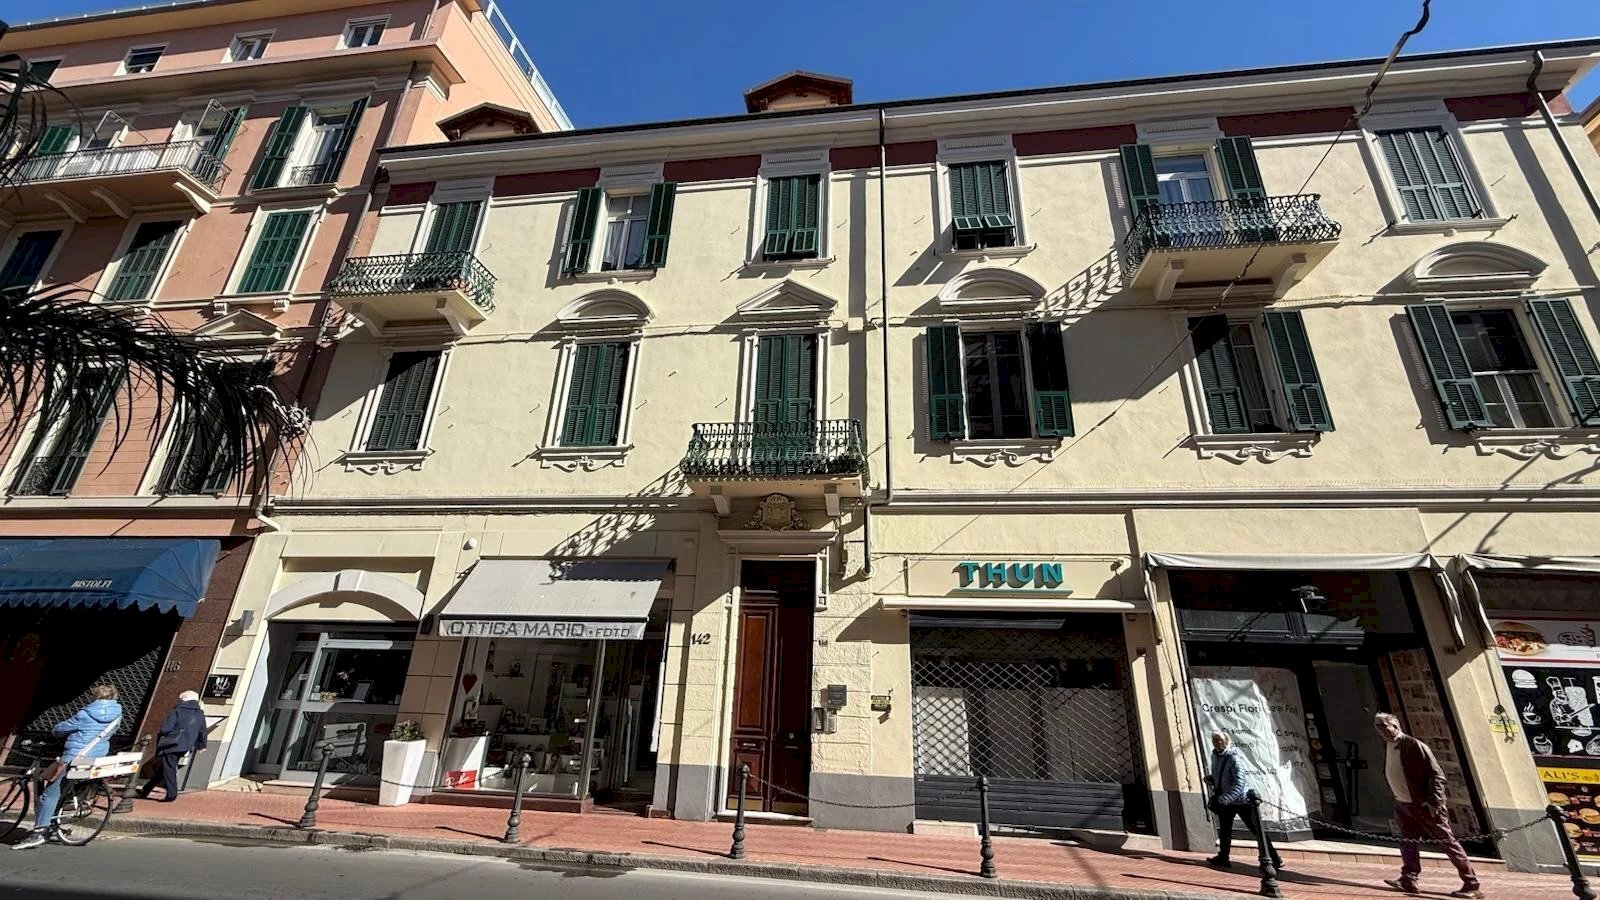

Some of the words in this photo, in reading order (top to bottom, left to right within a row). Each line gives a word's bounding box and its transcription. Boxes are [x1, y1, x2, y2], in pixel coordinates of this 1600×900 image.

[958, 561, 1063, 586] THUN
[71, 579, 113, 588] BISTOLFI
[451, 620, 518, 636] OTTICA
[523, 622, 585, 638] MARIO
[595, 628, 631, 638] FOTO
[692, 632, 711, 645] 142
[1202, 703, 1236, 714] Crespi
[1543, 770, 1580, 780] ALI'S
